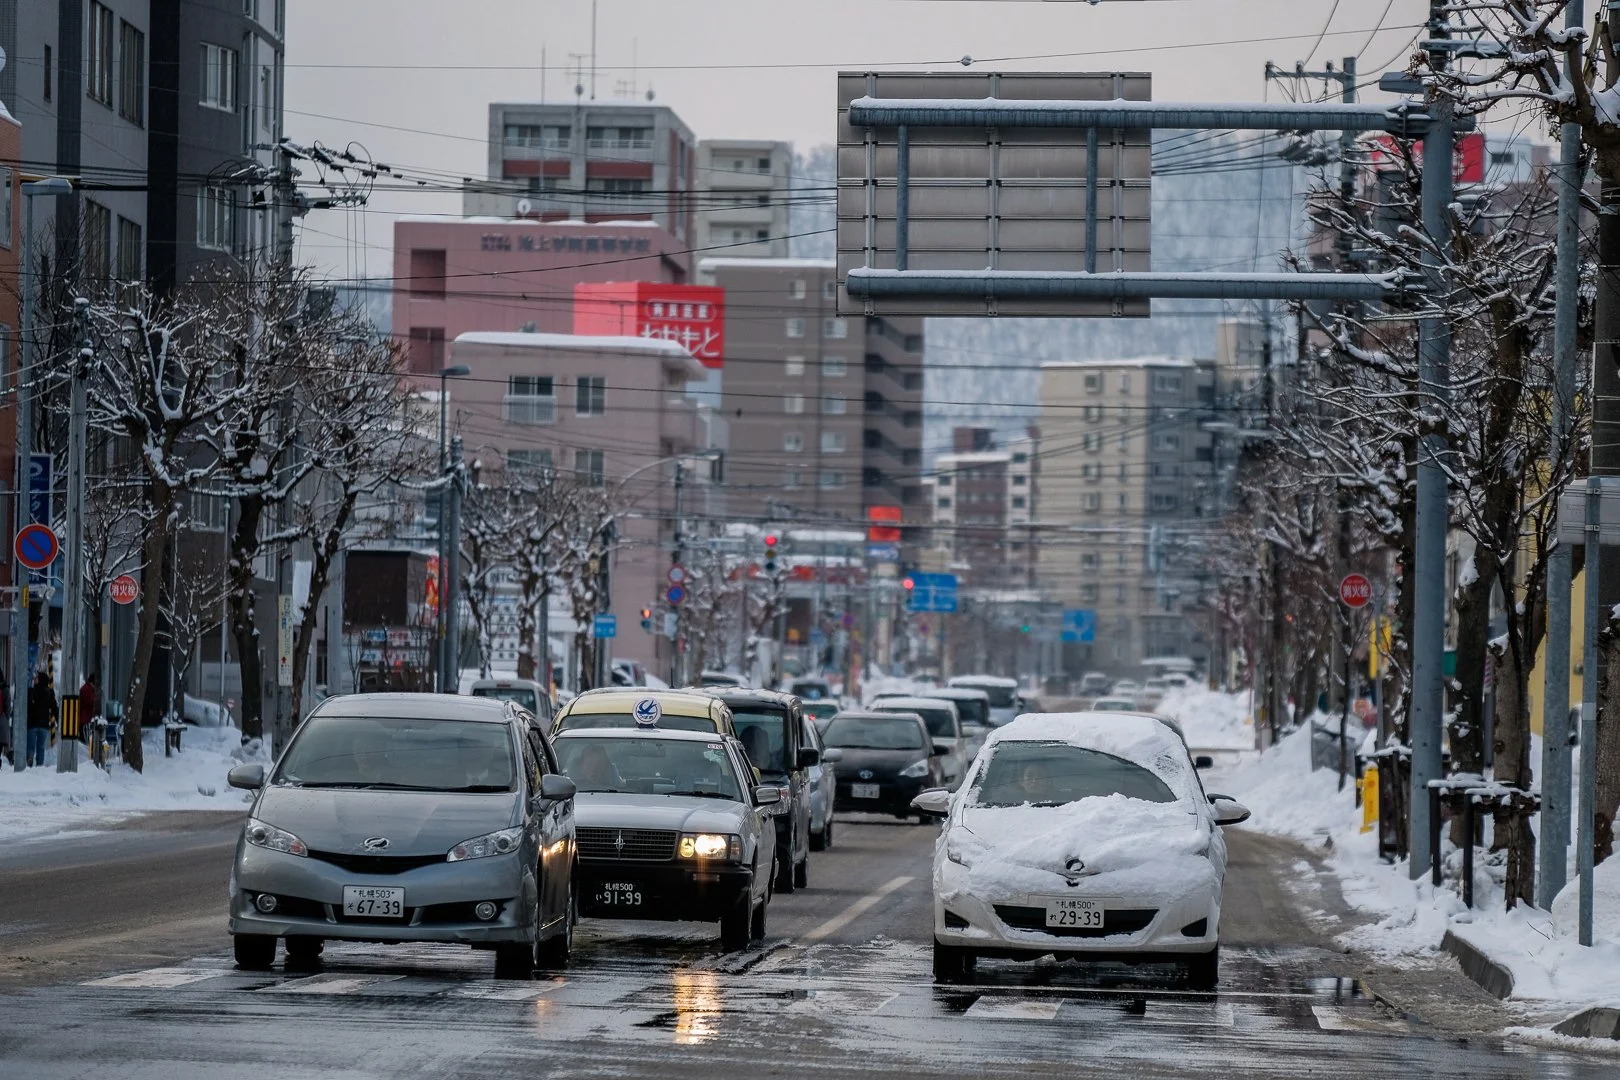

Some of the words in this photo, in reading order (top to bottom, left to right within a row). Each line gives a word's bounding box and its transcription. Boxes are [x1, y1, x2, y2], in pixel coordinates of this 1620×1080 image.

[112, 584, 136, 597] 消火栓
[604, 891, 642, 905] 91-99
[357, 900, 400, 915] 67-39
[1059, 910, 1101, 925] 29-39
